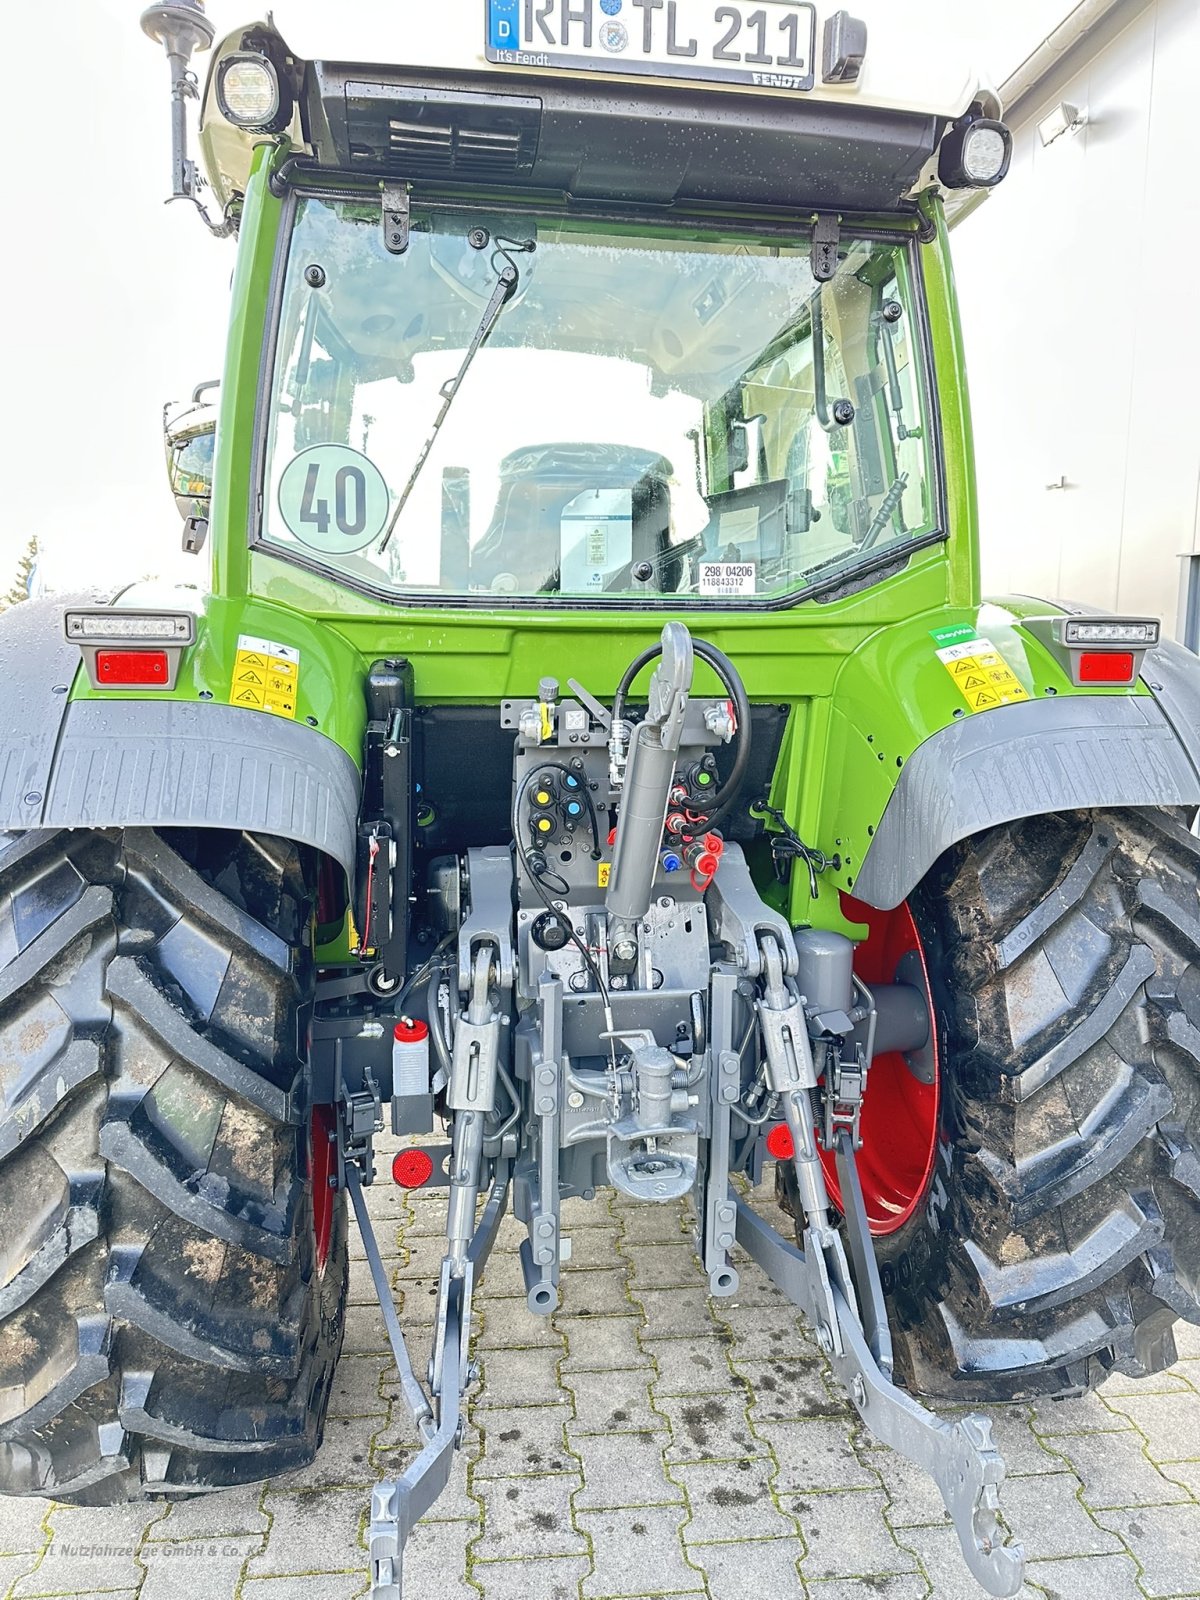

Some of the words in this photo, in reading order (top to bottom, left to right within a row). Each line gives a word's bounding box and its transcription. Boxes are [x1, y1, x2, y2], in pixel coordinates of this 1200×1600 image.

[498, 20, 510, 37] D
[524, 0, 593, 47] RH
[632, 0, 698, 57] TL
[712, 6, 804, 67] 211
[496, 49, 513, 62] It's
[752, 72, 804, 89] FENDT
[300, 463, 366, 536] 40
